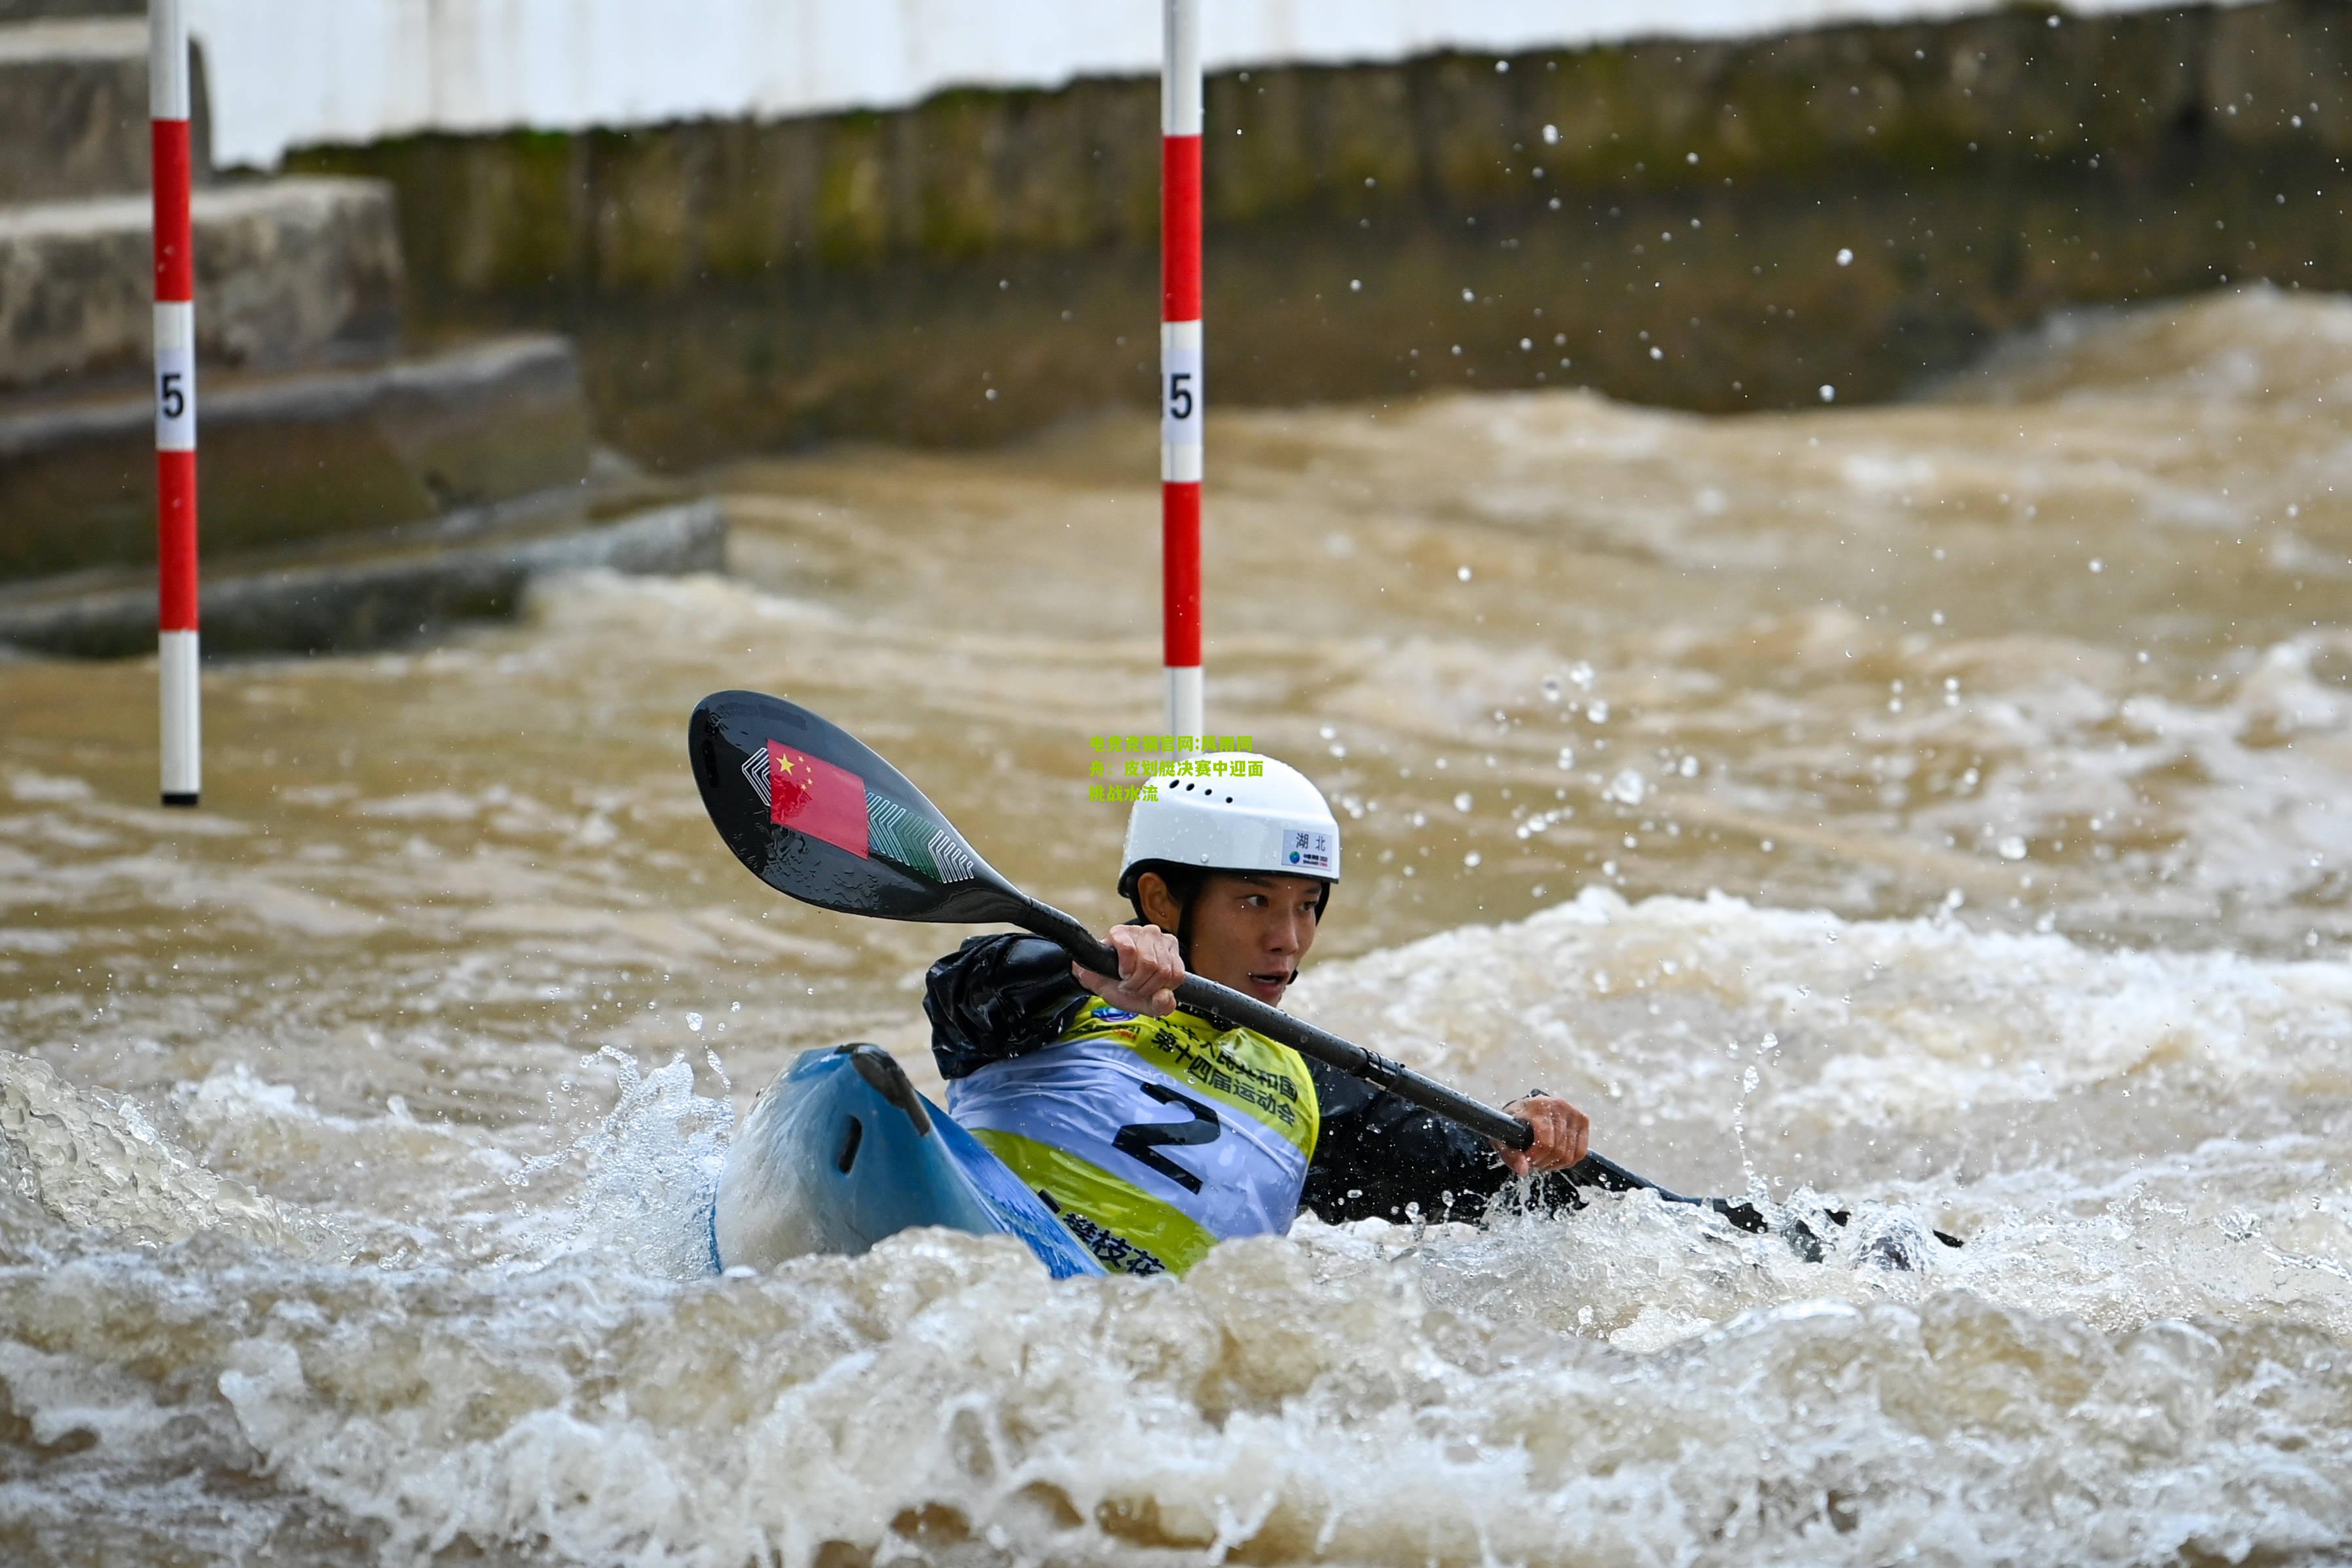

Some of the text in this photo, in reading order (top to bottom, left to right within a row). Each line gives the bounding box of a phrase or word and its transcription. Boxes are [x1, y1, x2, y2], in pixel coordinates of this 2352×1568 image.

[162, 373, 184, 419] 5
[1170, 373, 1192, 420] 5
[1296, 833, 1326, 852] 湖北
[1151, 1027, 1296, 1127] 第十四届运动会
[1111, 1082, 1221, 1195] 2
